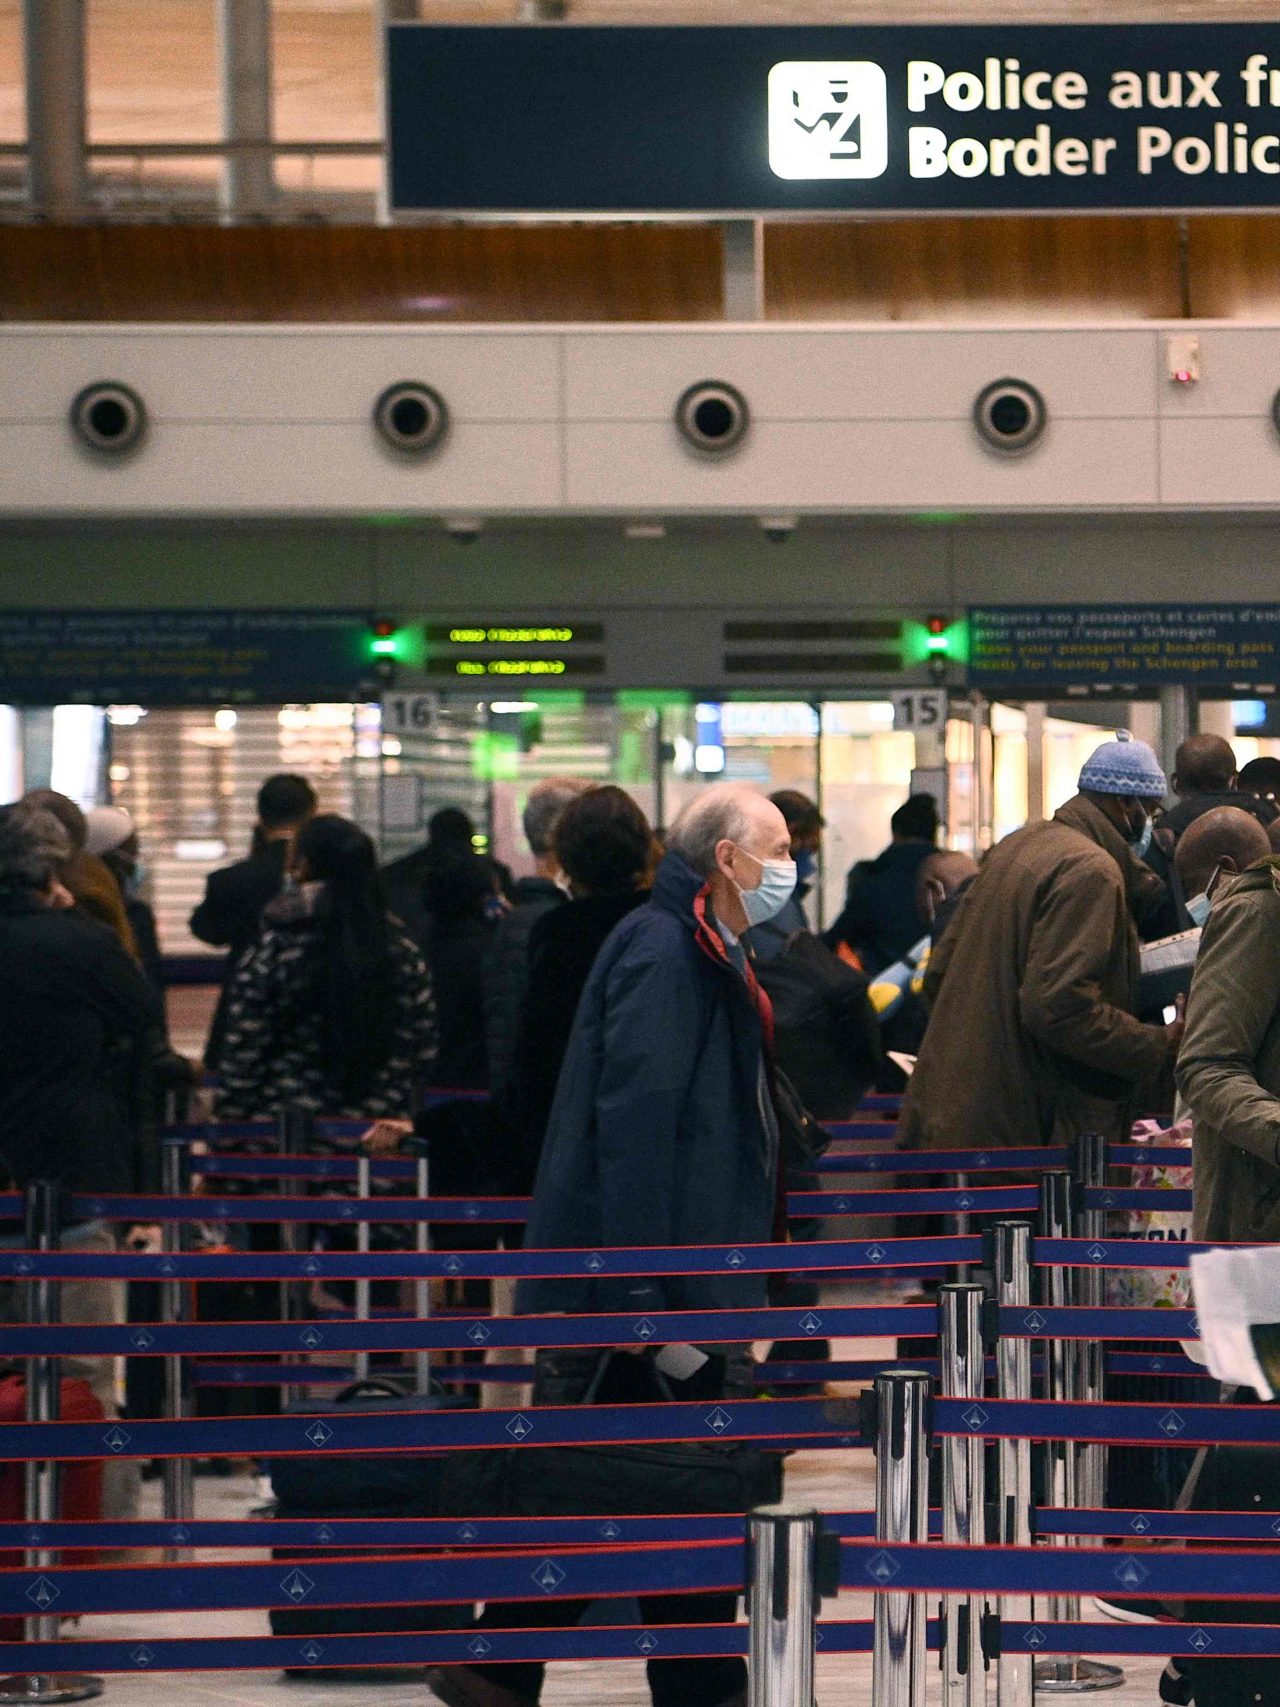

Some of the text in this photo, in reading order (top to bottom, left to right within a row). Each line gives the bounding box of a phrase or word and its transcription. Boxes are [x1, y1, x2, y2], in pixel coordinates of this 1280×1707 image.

[907, 57, 1088, 112] Police
[1108, 69, 1222, 109] aux
[908, 123, 1117, 179] Border
[392, 697, 432, 728] 16
[901, 697, 938, 725] 15
